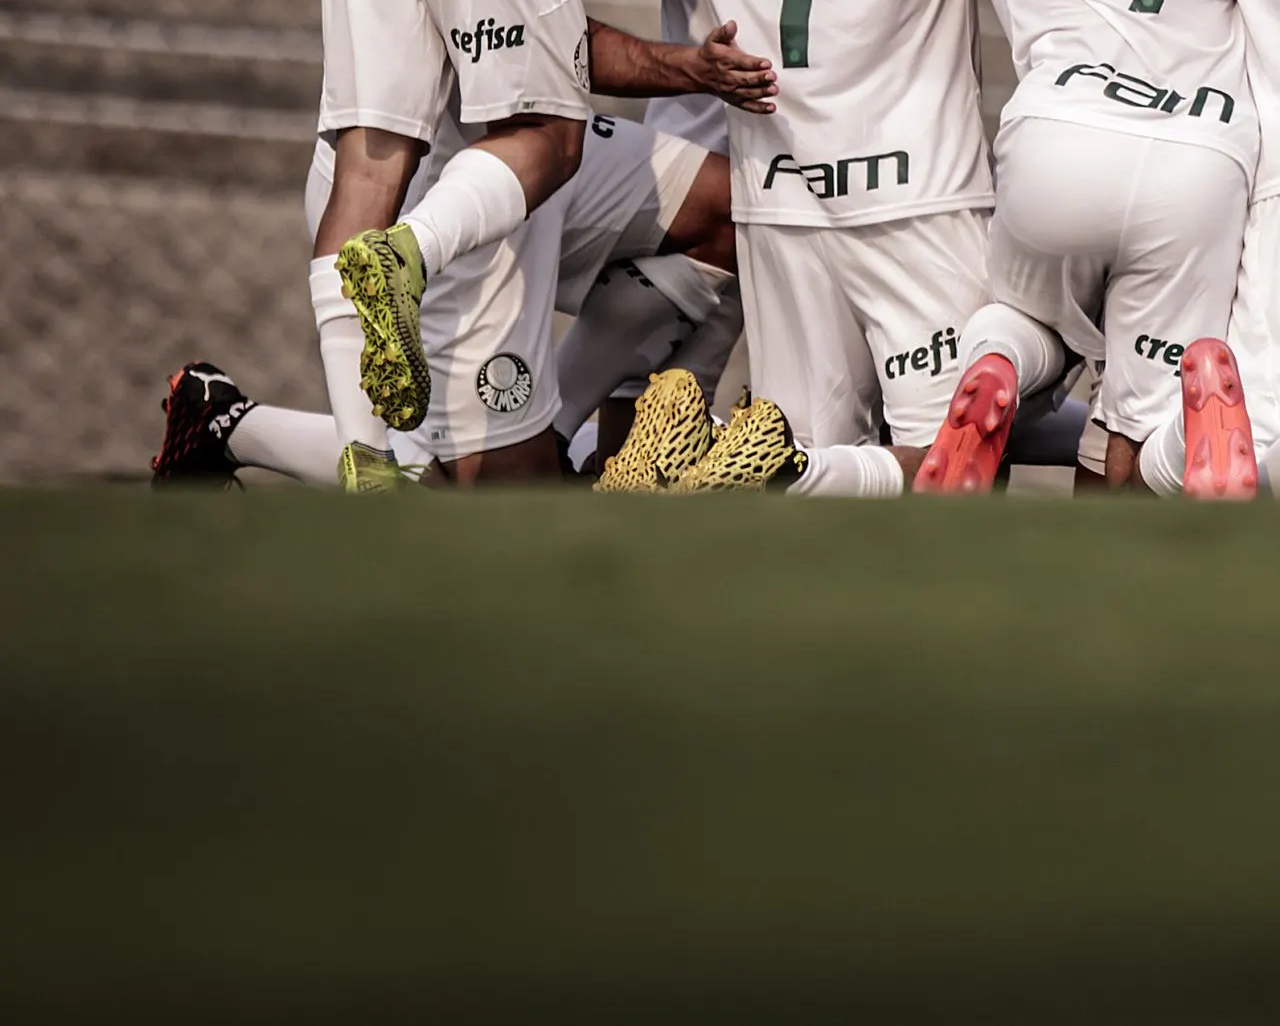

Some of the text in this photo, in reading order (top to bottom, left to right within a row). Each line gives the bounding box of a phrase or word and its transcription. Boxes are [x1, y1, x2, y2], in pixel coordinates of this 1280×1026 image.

[884, 327, 962, 379] crefi
[1134, 334, 1184, 377] cre
[478, 372, 531, 412] PALMEIRAS
